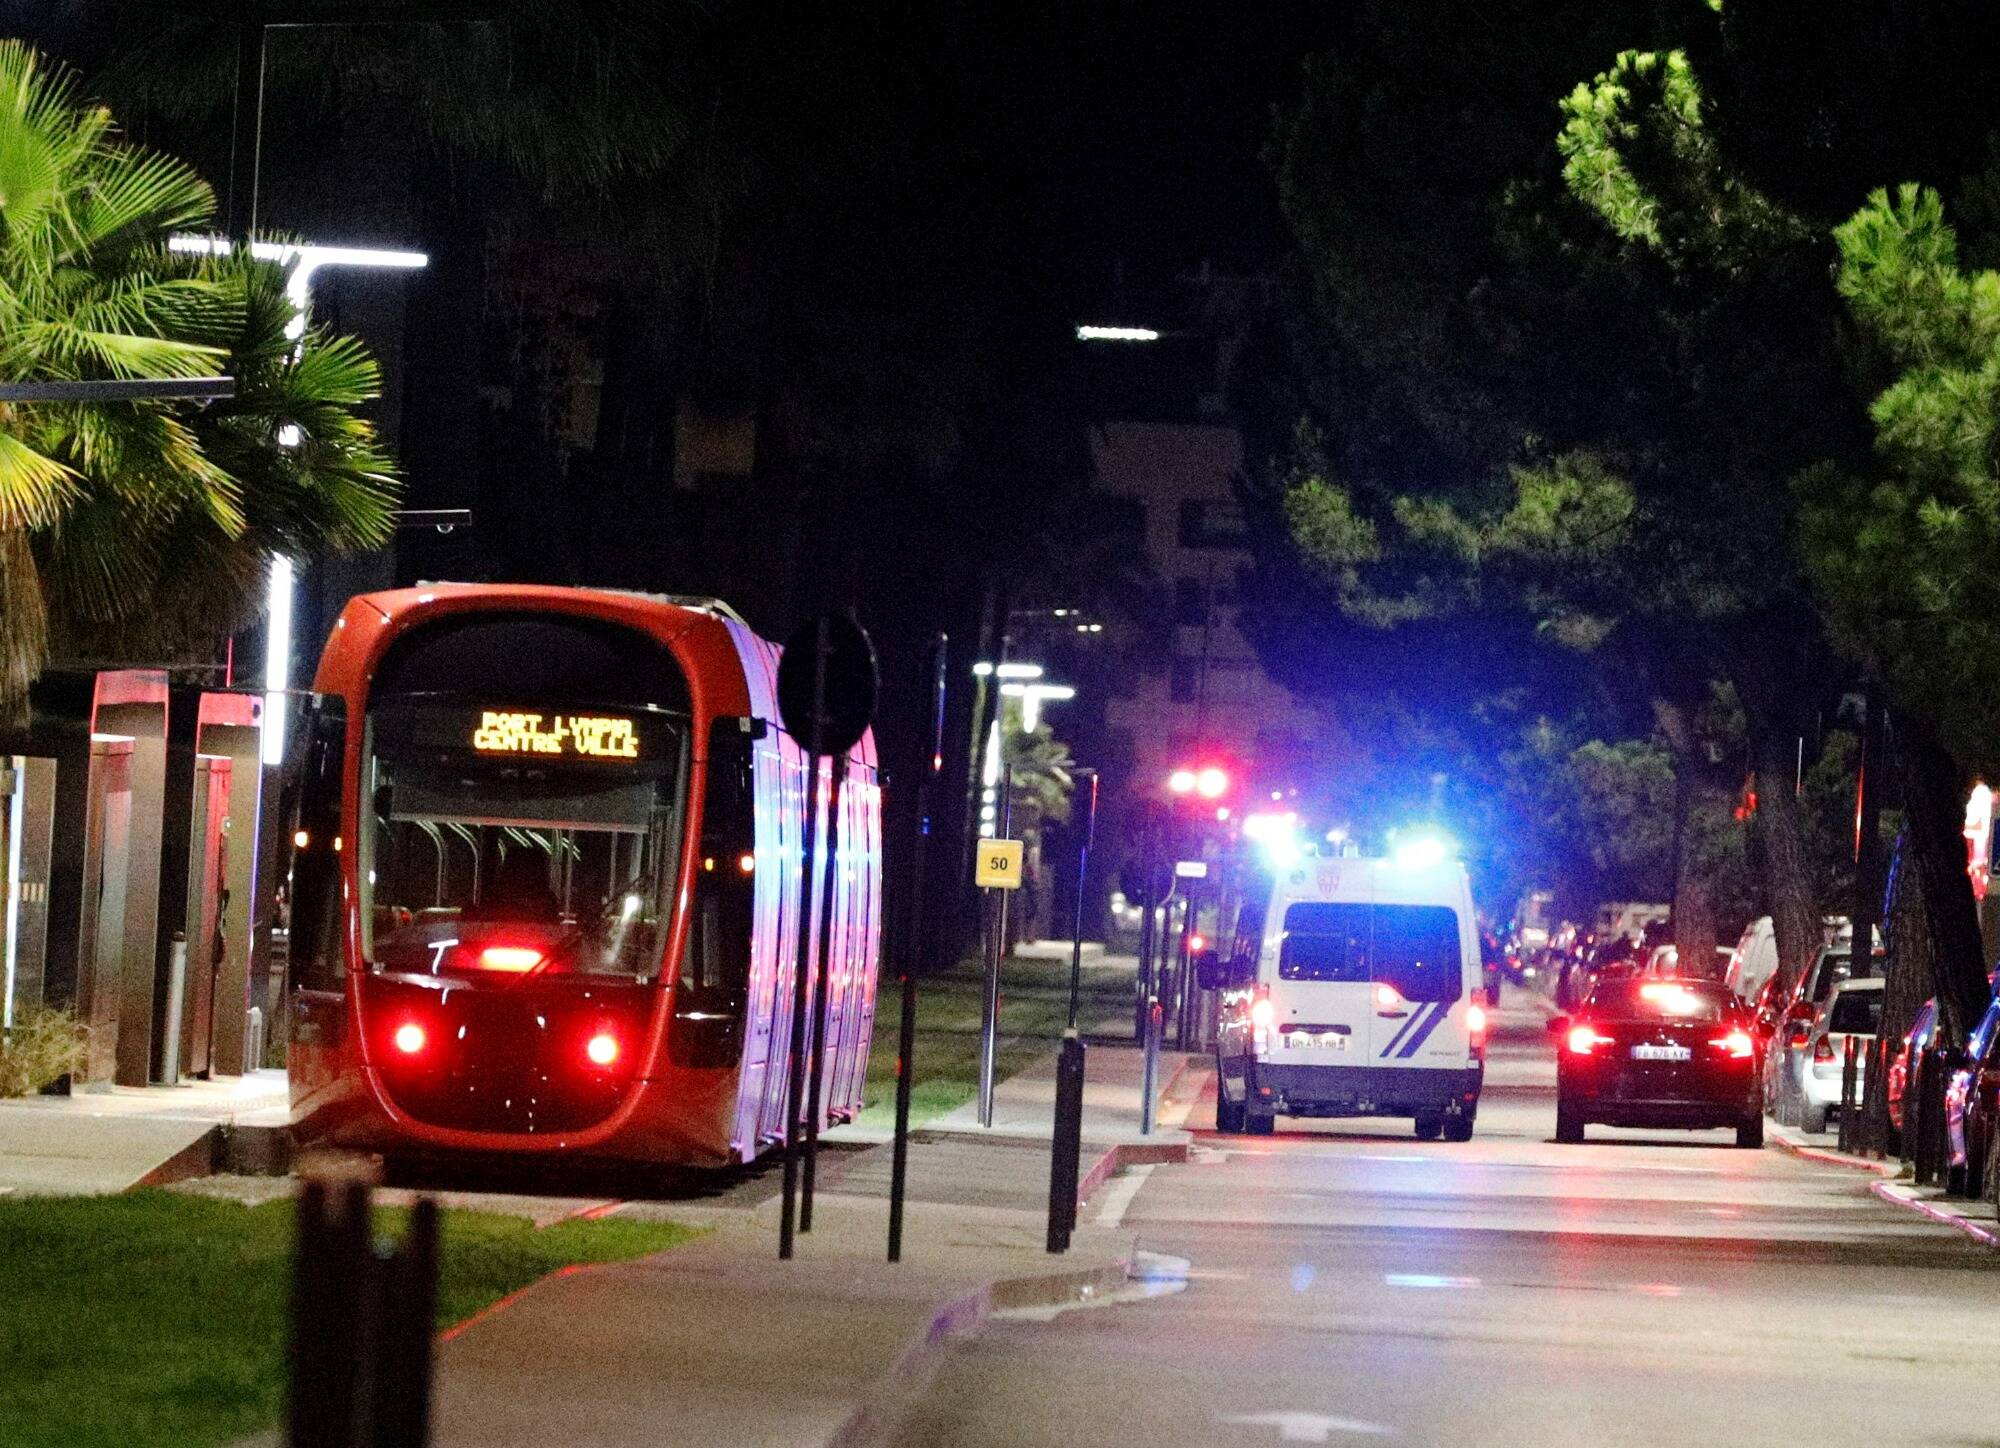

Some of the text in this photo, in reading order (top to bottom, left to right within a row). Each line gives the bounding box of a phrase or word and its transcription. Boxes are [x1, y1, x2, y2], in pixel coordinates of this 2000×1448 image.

[482, 711, 543, 733] PORT
[473, 728, 639, 757] CENTRE VILLE
[991, 856, 1008, 870] 50
